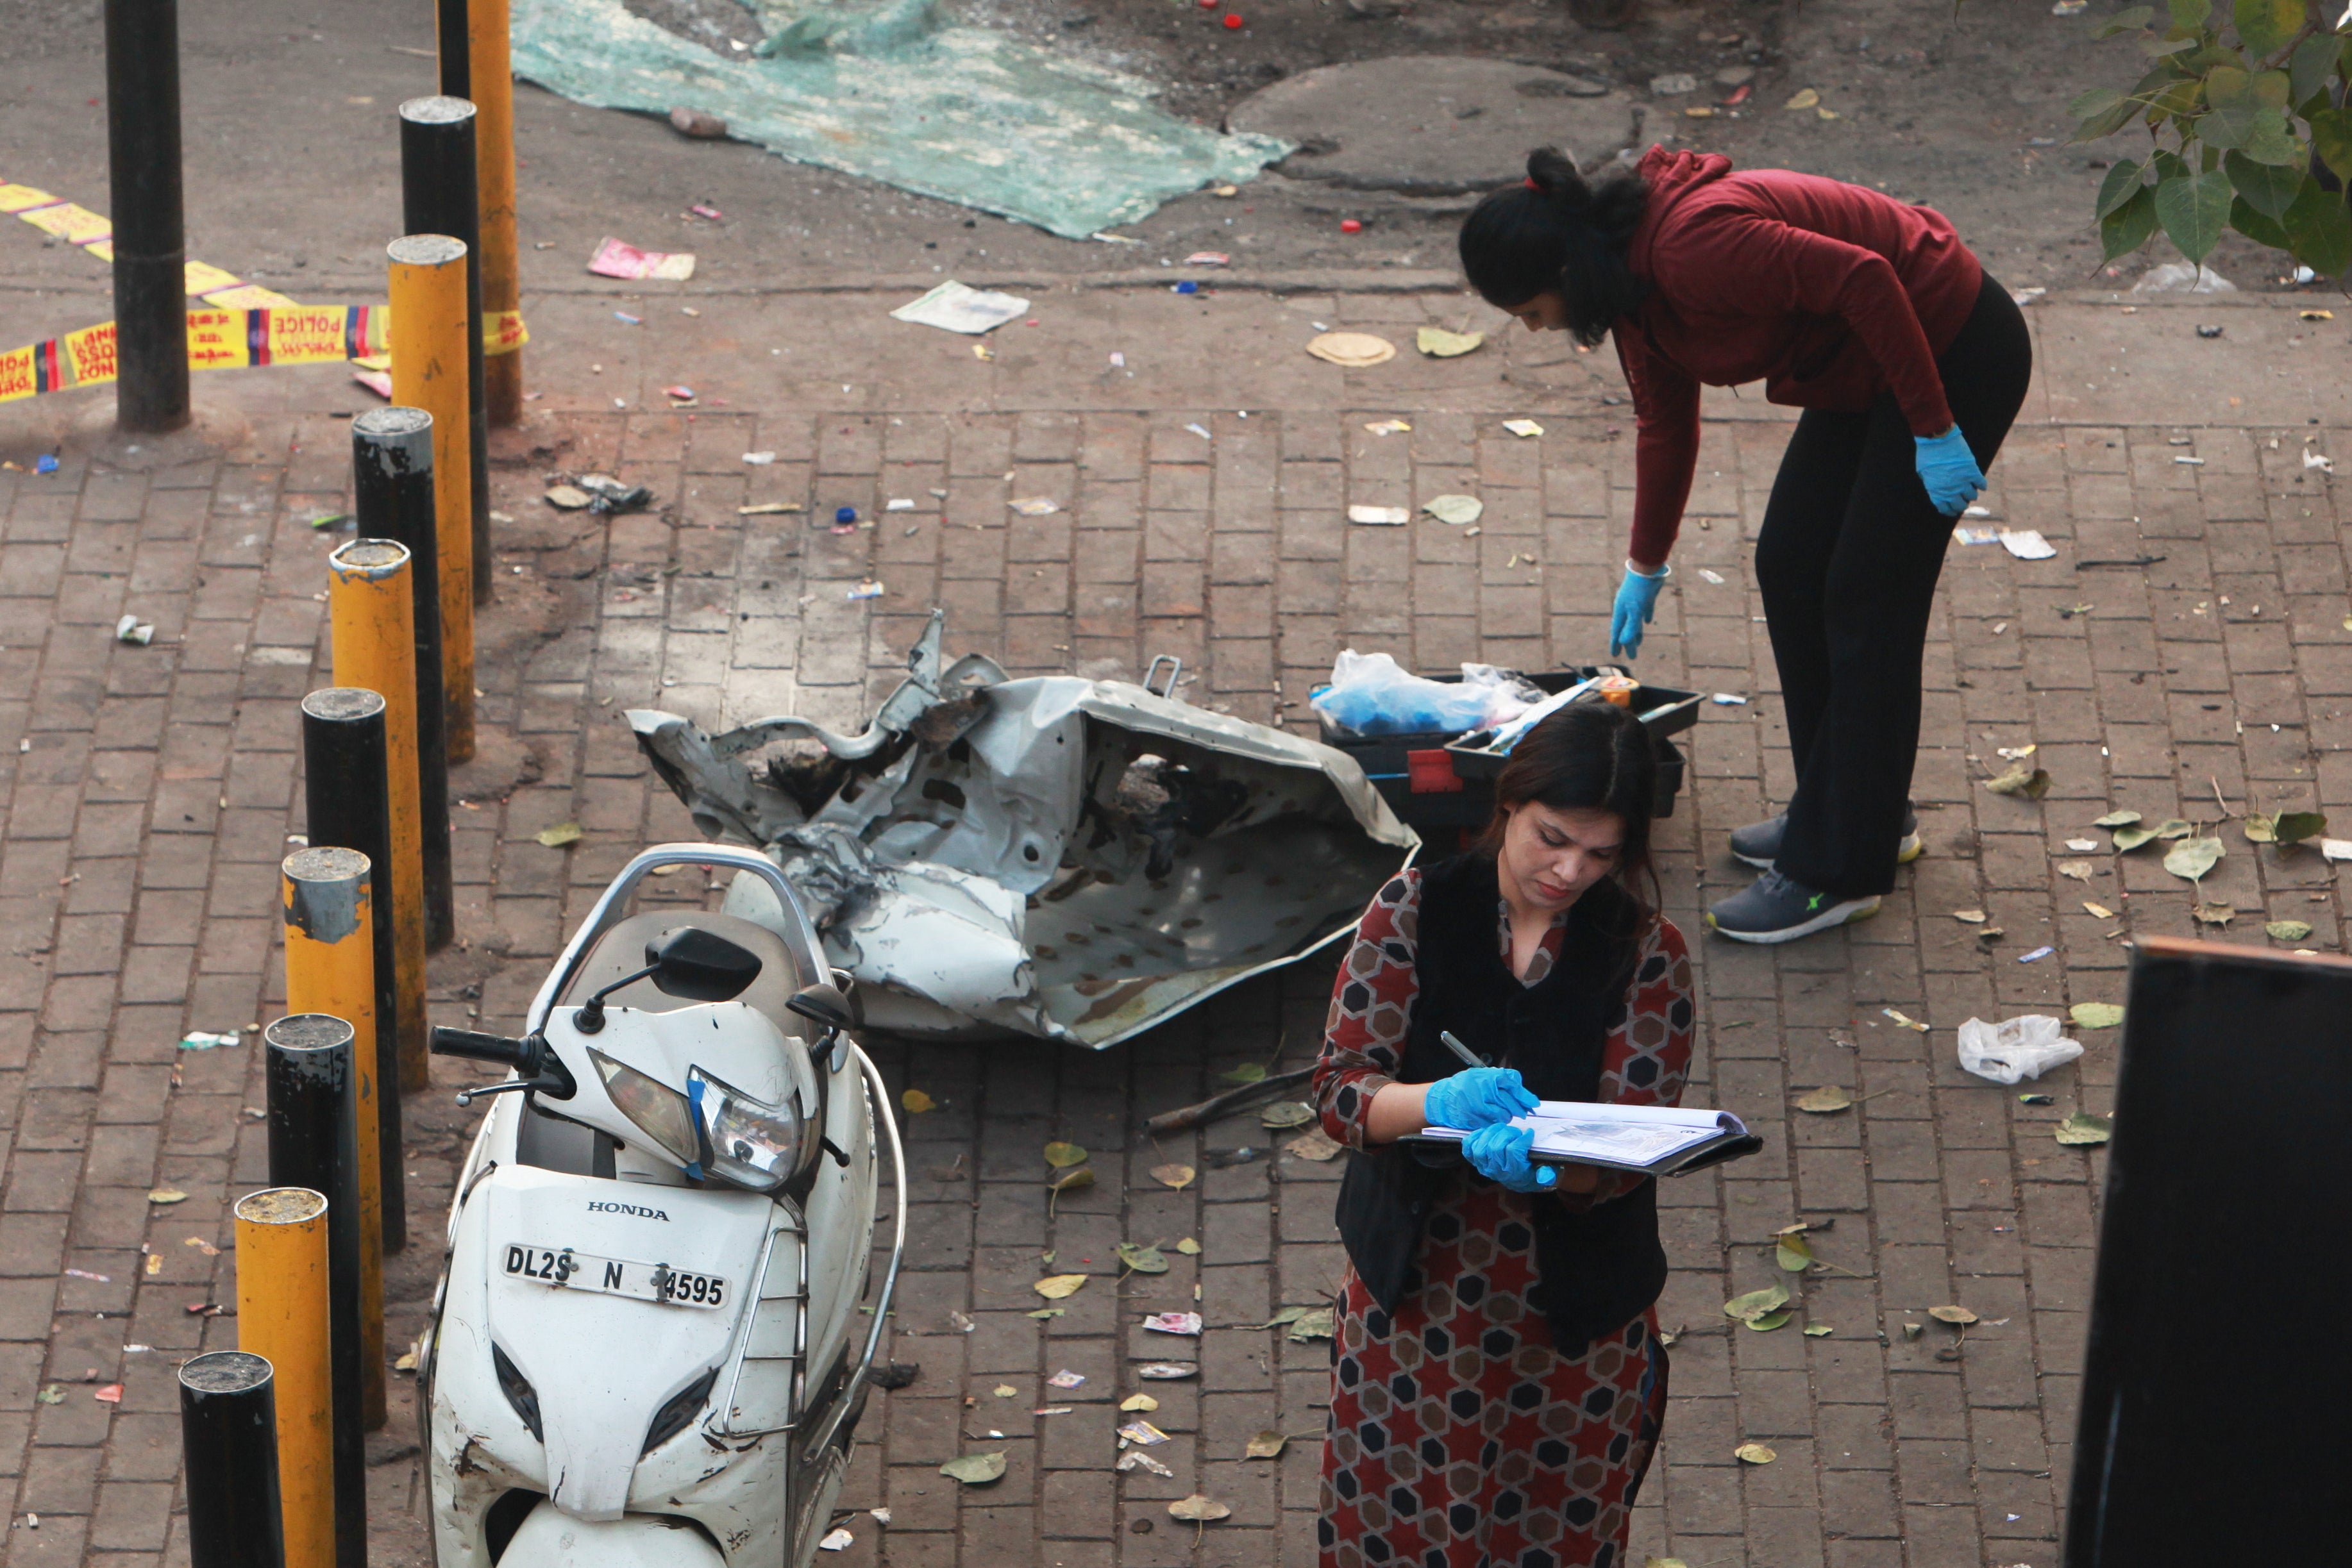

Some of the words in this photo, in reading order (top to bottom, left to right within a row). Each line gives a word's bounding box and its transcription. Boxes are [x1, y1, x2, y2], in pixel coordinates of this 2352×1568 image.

[274, 315, 341, 334] POLICE
[588, 1201, 670, 1222] HONDA
[506, 1246, 572, 1281] DL2S
[604, 1262, 623, 1290] N
[664, 1272, 723, 1306] 4595
